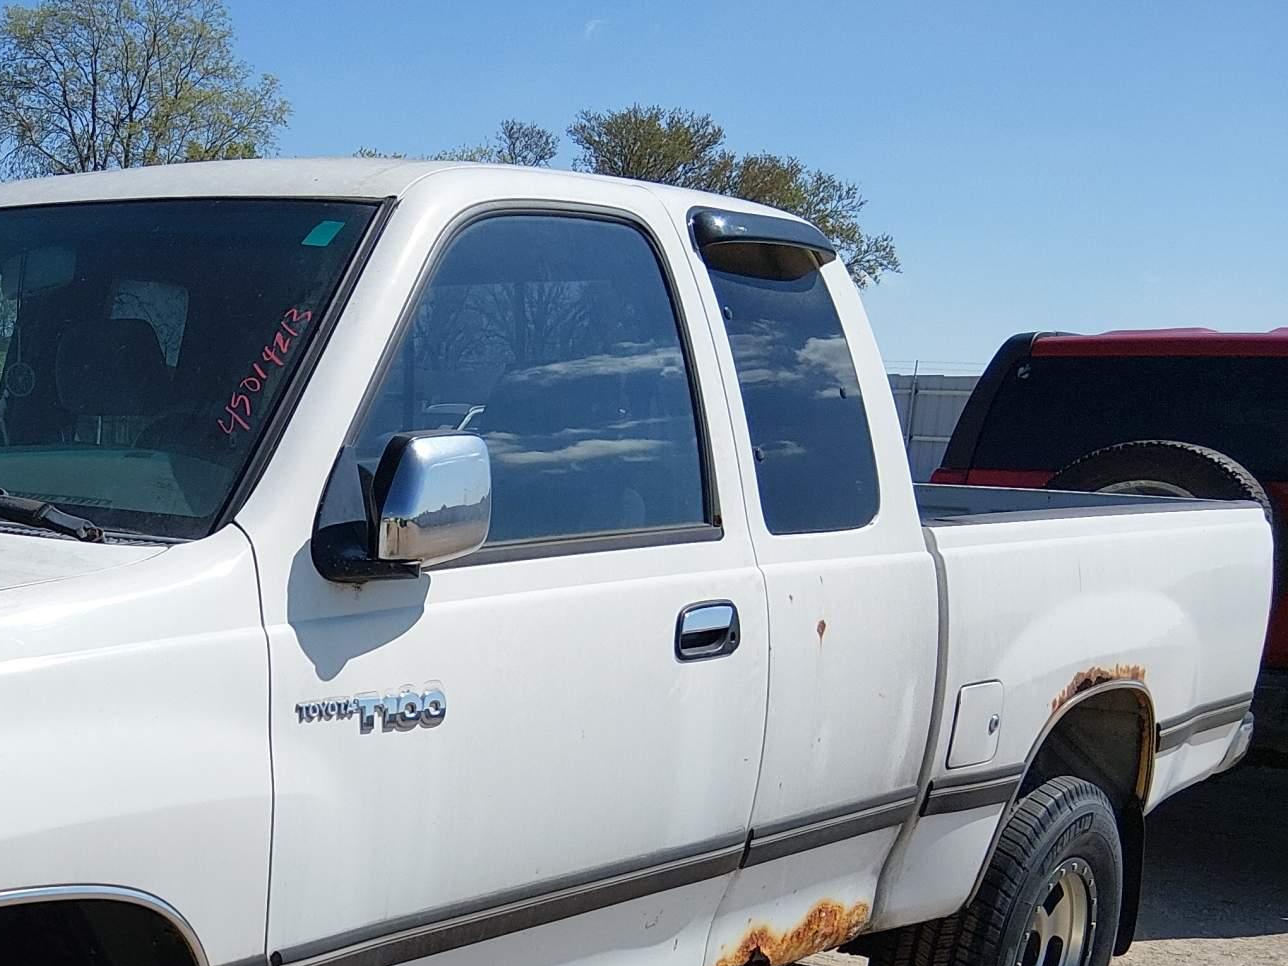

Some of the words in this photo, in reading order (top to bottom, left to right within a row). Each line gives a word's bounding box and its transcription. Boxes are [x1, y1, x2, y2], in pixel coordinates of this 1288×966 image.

[217, 306, 313, 434] 45014213
[295, 698, 359, 722] TOYOTA
[358, 689, 447, 733] T100
